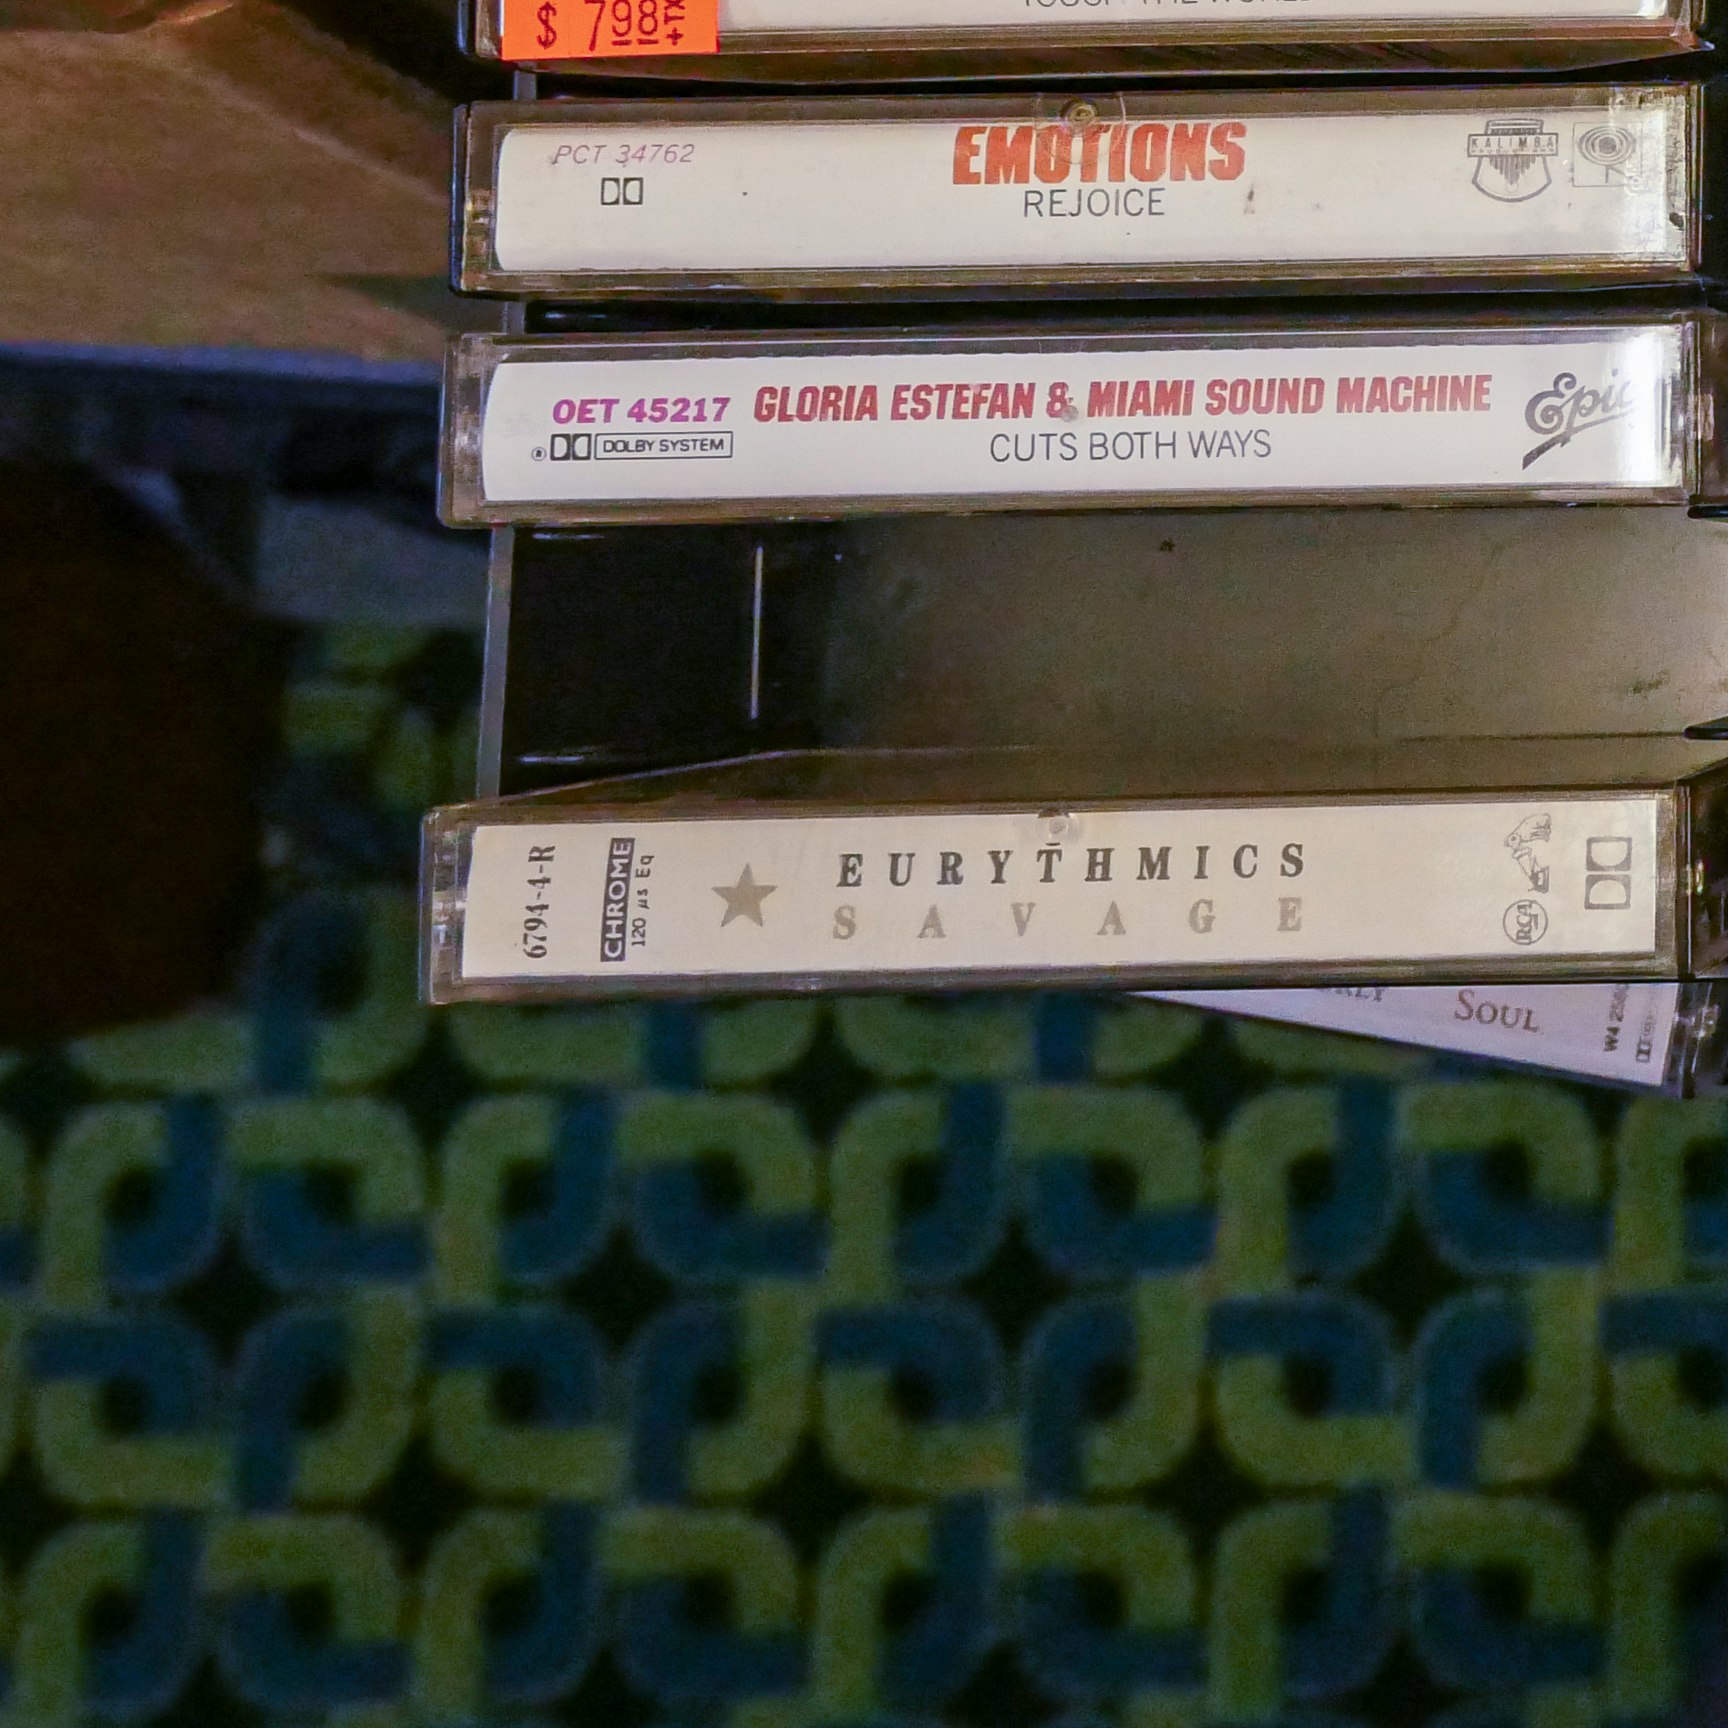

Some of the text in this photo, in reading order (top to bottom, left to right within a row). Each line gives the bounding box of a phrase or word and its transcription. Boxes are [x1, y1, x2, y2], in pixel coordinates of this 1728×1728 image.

[953, 121, 1247, 186] EMOTIONS
[1024, 187, 1165, 219] REJOICE
[753, 374, 1493, 423] GLORIA ESTEFAN & MIAMI SOUND MACHINE
[836, 842, 1304, 888] EURYTHMICS
[833, 897, 1303, 941] SAVAGE
